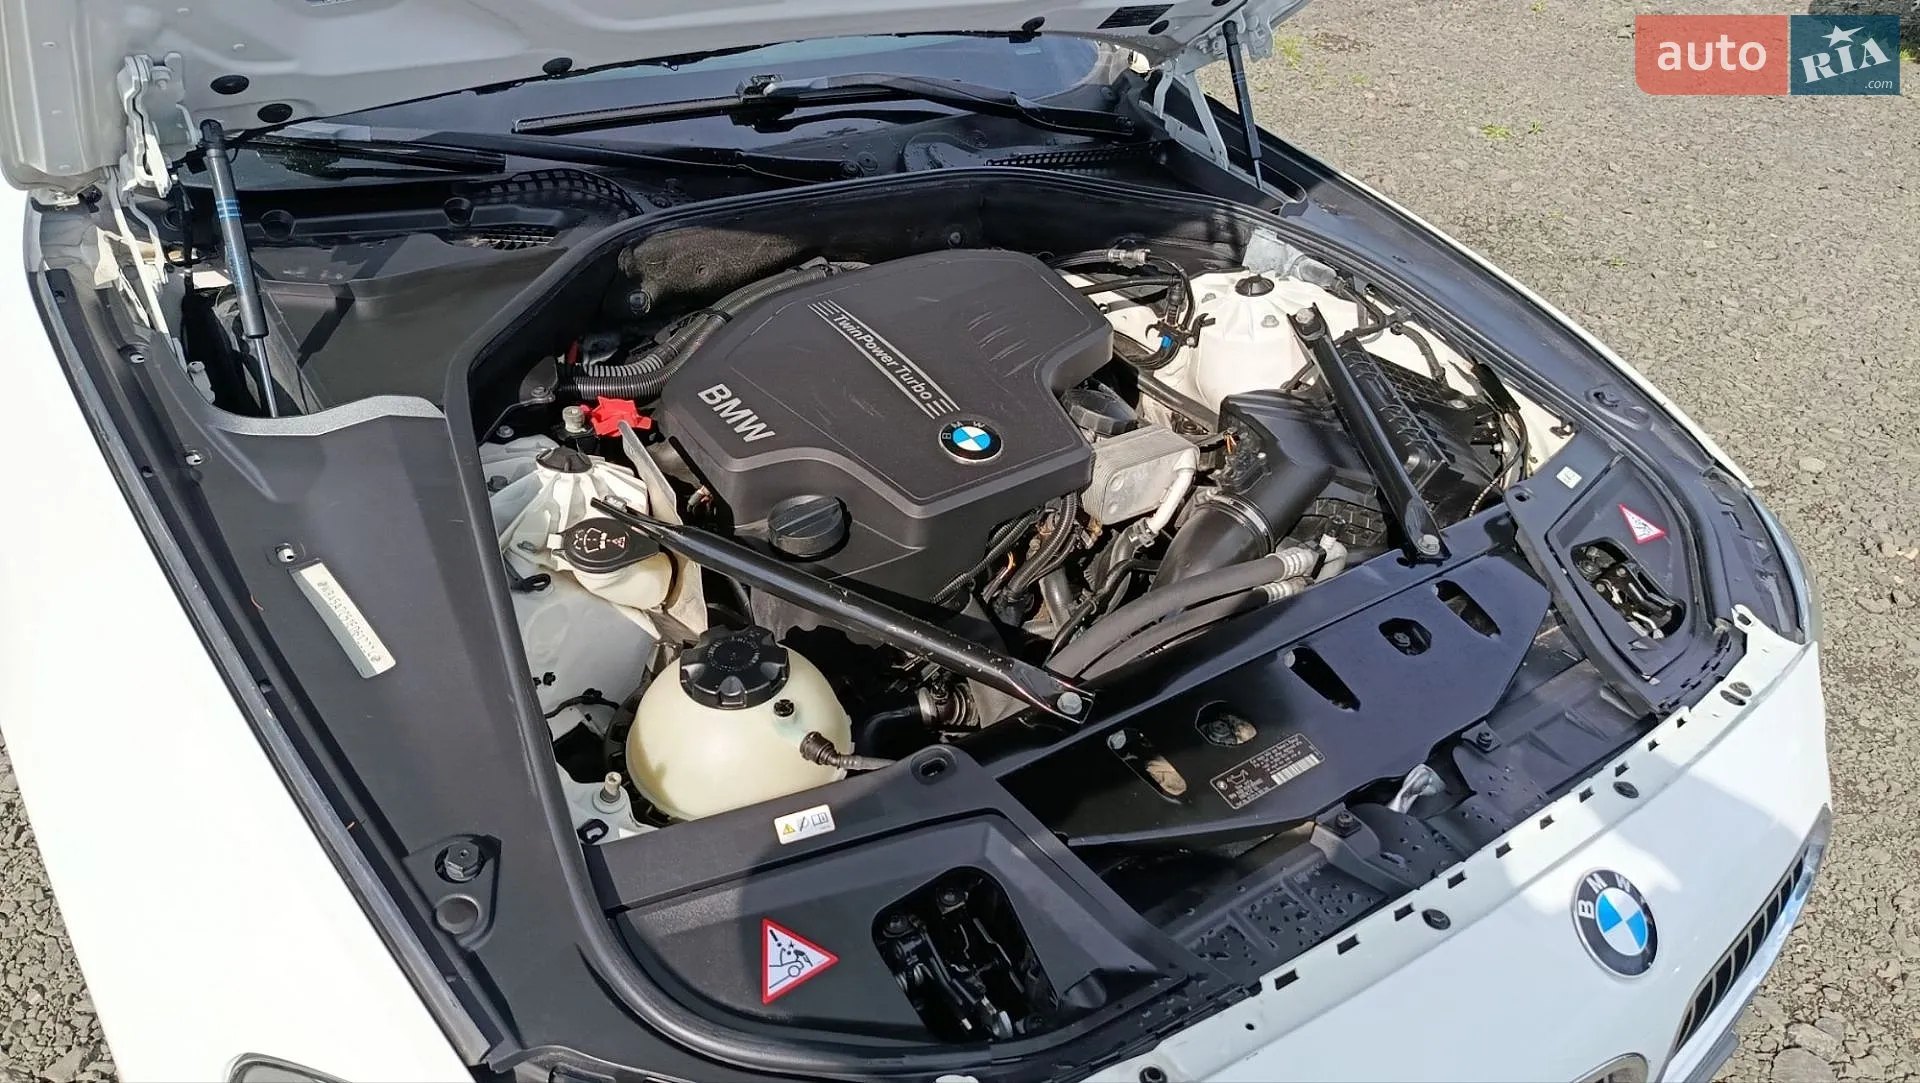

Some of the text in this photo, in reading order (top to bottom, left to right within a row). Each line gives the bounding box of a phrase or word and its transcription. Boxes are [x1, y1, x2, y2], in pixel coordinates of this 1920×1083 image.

[833, 314, 933, 400] TwinPower Turbo
[697, 383, 776, 443] BMW
[941, 421, 985, 440] BMW
[1577, 872, 1631, 920] BMW
